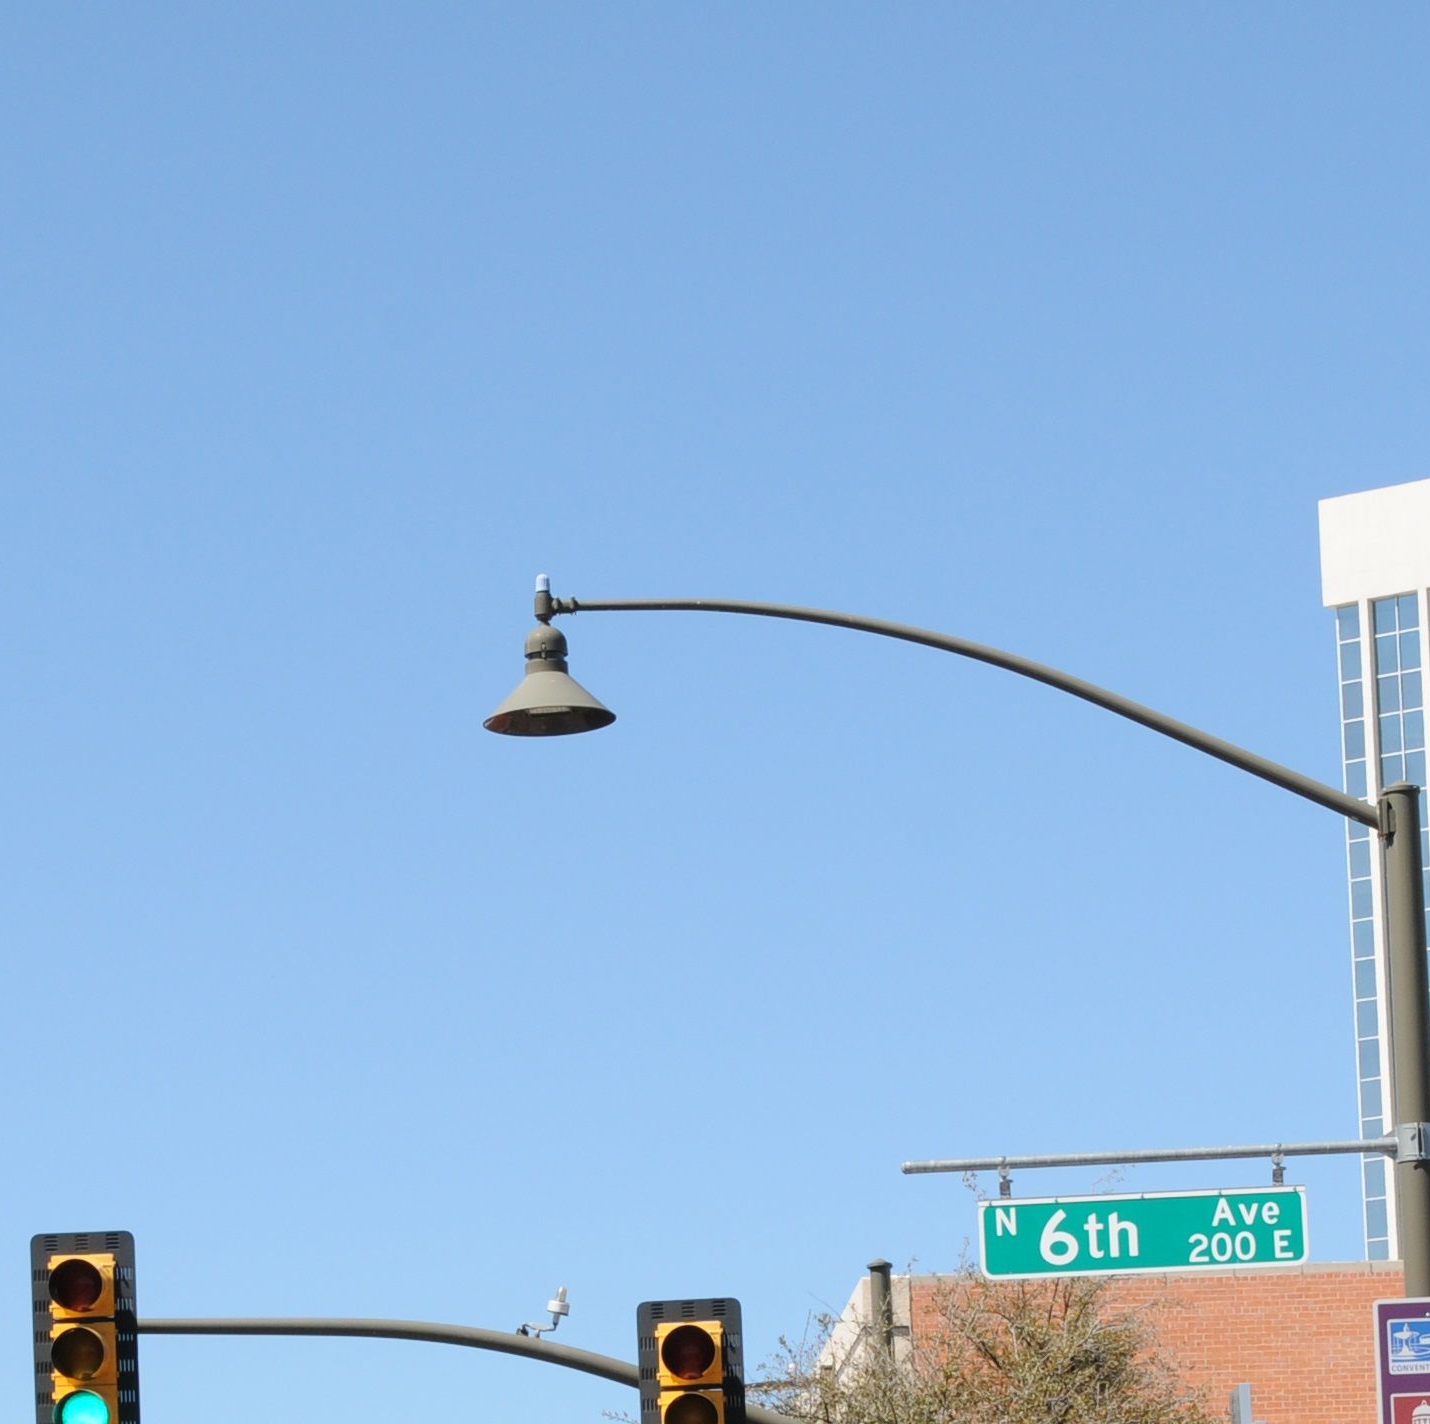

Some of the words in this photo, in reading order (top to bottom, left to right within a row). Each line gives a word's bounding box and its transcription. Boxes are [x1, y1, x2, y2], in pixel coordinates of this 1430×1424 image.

[1211, 1197, 1281, 1228] Ave
[995, 1207, 1017, 1236] N
[1039, 1209, 1140, 1266] 6th
[1188, 1231, 1257, 1263] 200
[1274, 1229, 1294, 1259] E
